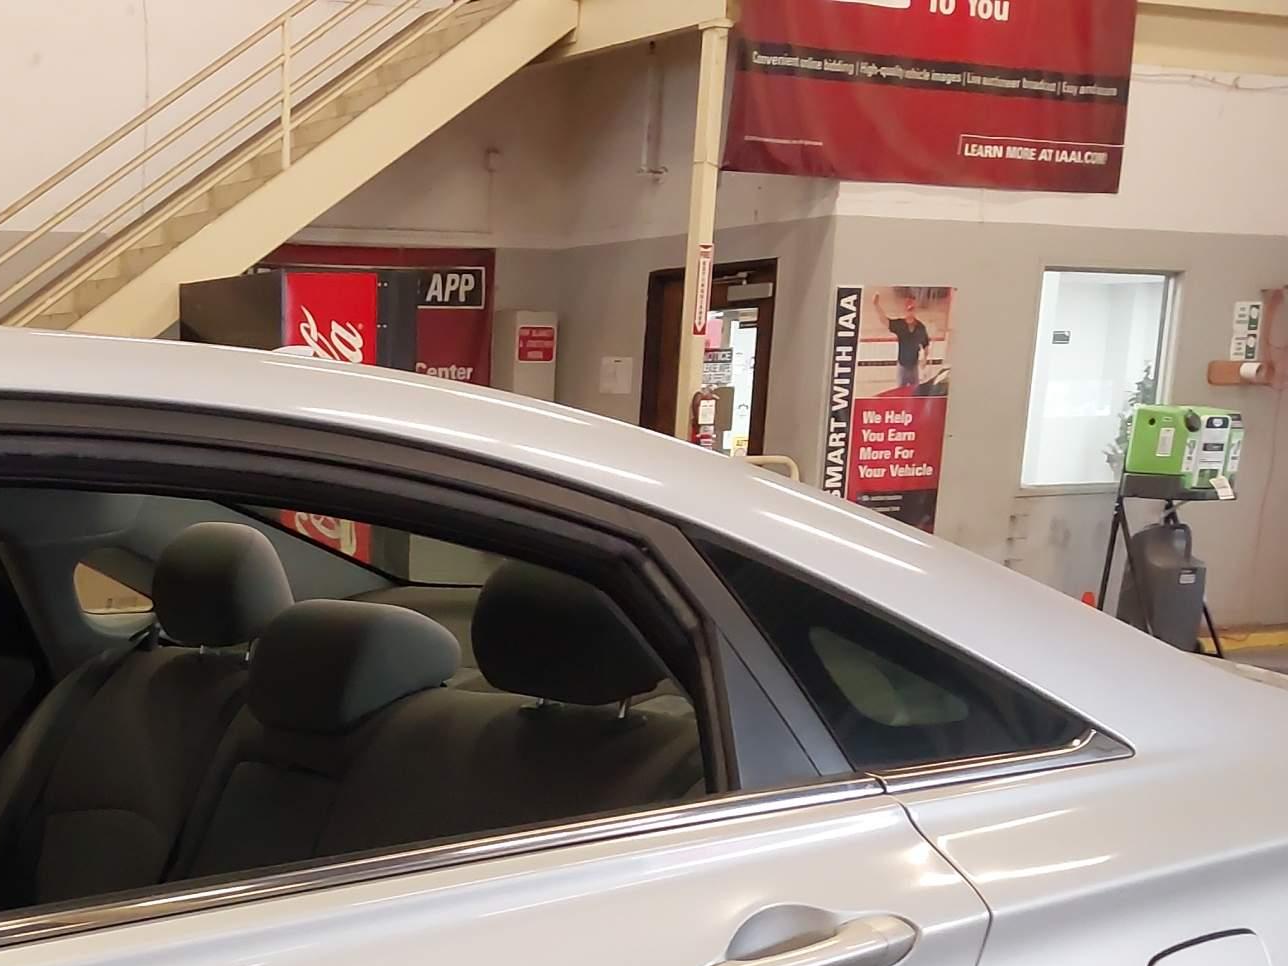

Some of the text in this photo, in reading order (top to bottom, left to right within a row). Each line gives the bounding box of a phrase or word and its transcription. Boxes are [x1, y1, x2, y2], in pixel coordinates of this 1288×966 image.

[968, 0, 1010, 21] You
[964, 143, 1003, 159] LEARN
[1006, 146, 1036, 161] MORE
[1038, 149, 1054, 161] AT
[426, 273, 475, 302] APP
[837, 294, 858, 337] IAA
[415, 362, 473, 380] Center
[831, 346, 853, 411] WITH
[862, 410, 913, 426] We Help
[861, 428, 916, 442] You Earn
[859, 446, 915, 460] More For
[858, 463, 933, 478] Your Vehicle
